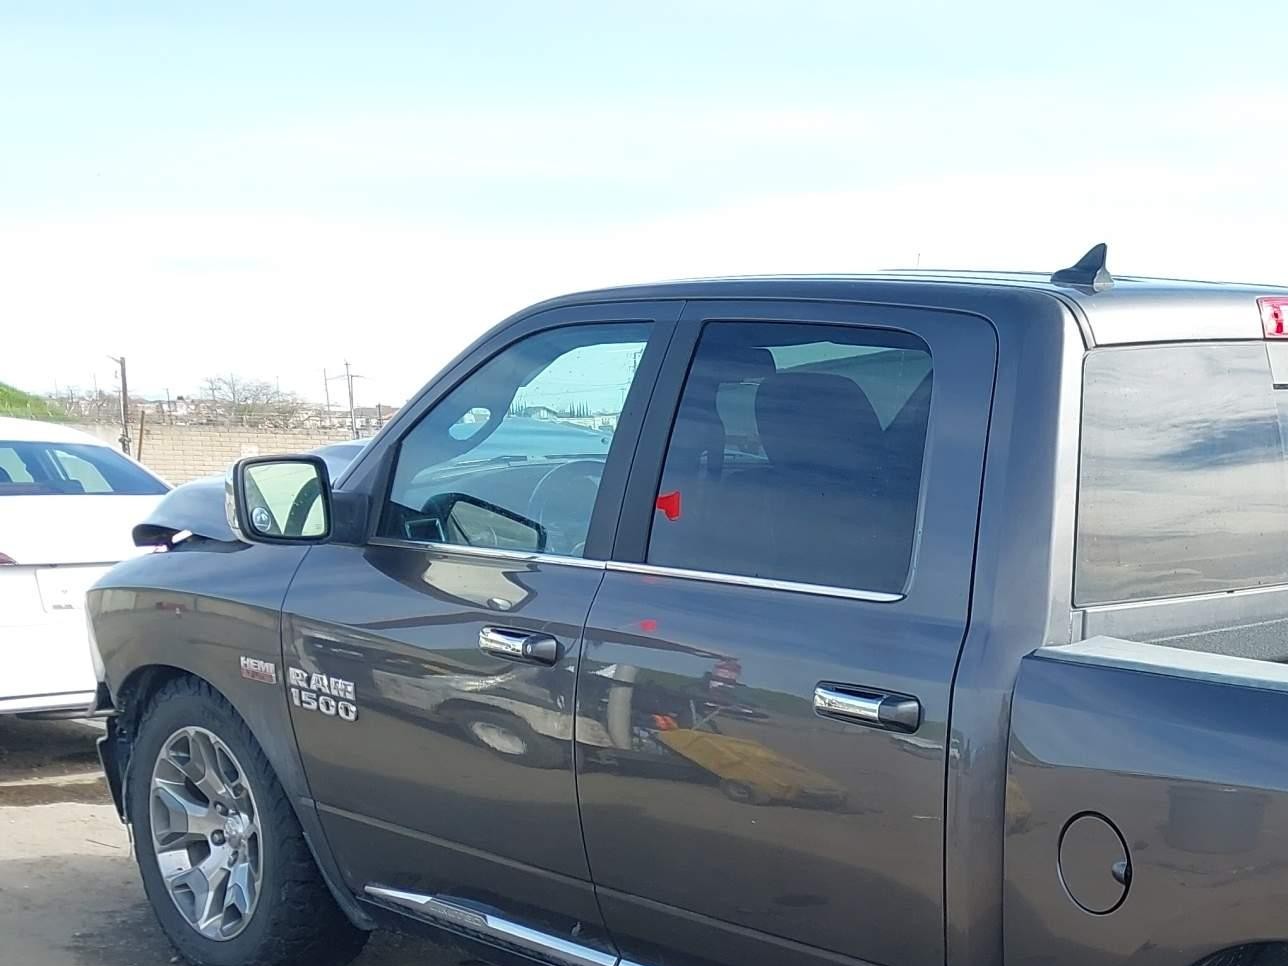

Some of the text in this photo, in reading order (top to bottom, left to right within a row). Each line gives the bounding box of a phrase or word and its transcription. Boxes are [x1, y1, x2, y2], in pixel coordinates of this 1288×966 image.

[240, 655, 275, 674] HEMI
[289, 667, 356, 700] RAM
[290, 687, 358, 722] 1500
